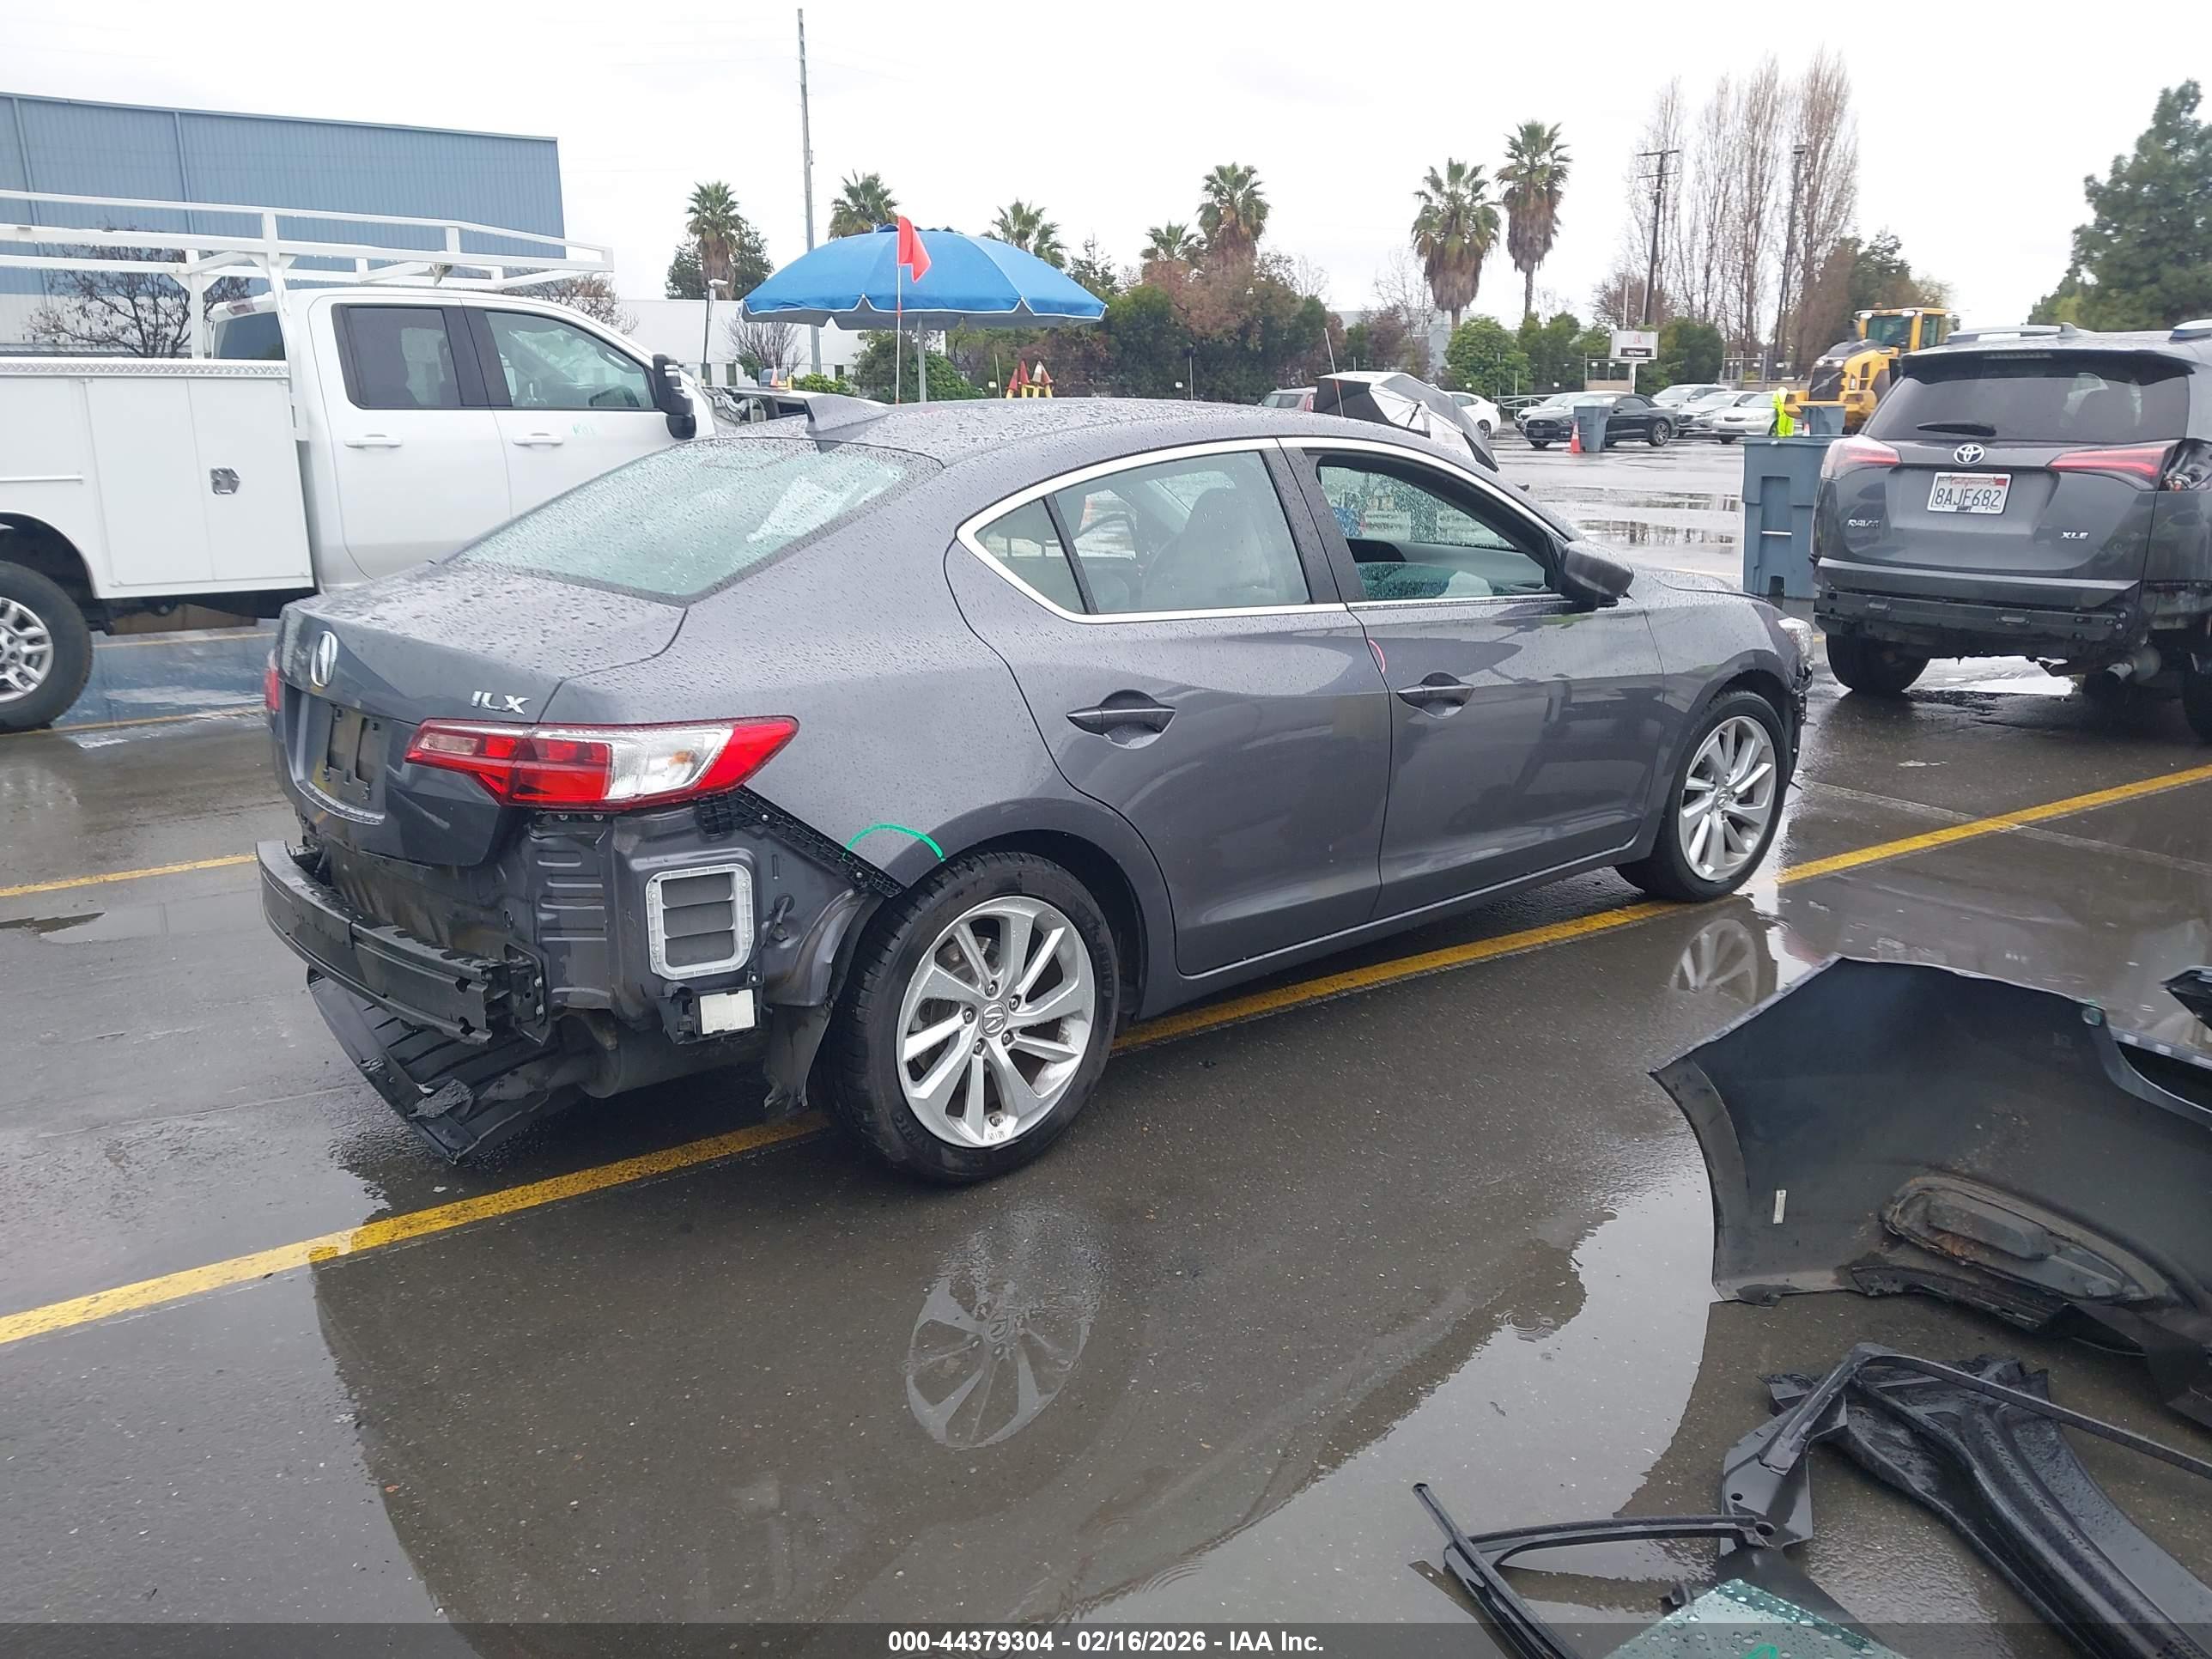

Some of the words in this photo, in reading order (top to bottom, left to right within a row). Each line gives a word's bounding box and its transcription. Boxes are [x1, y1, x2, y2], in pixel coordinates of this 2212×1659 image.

[1935, 487, 2002, 507] 8AJF682
[2061, 532, 2089, 540] XLE
[471, 690, 531, 715] ILX
